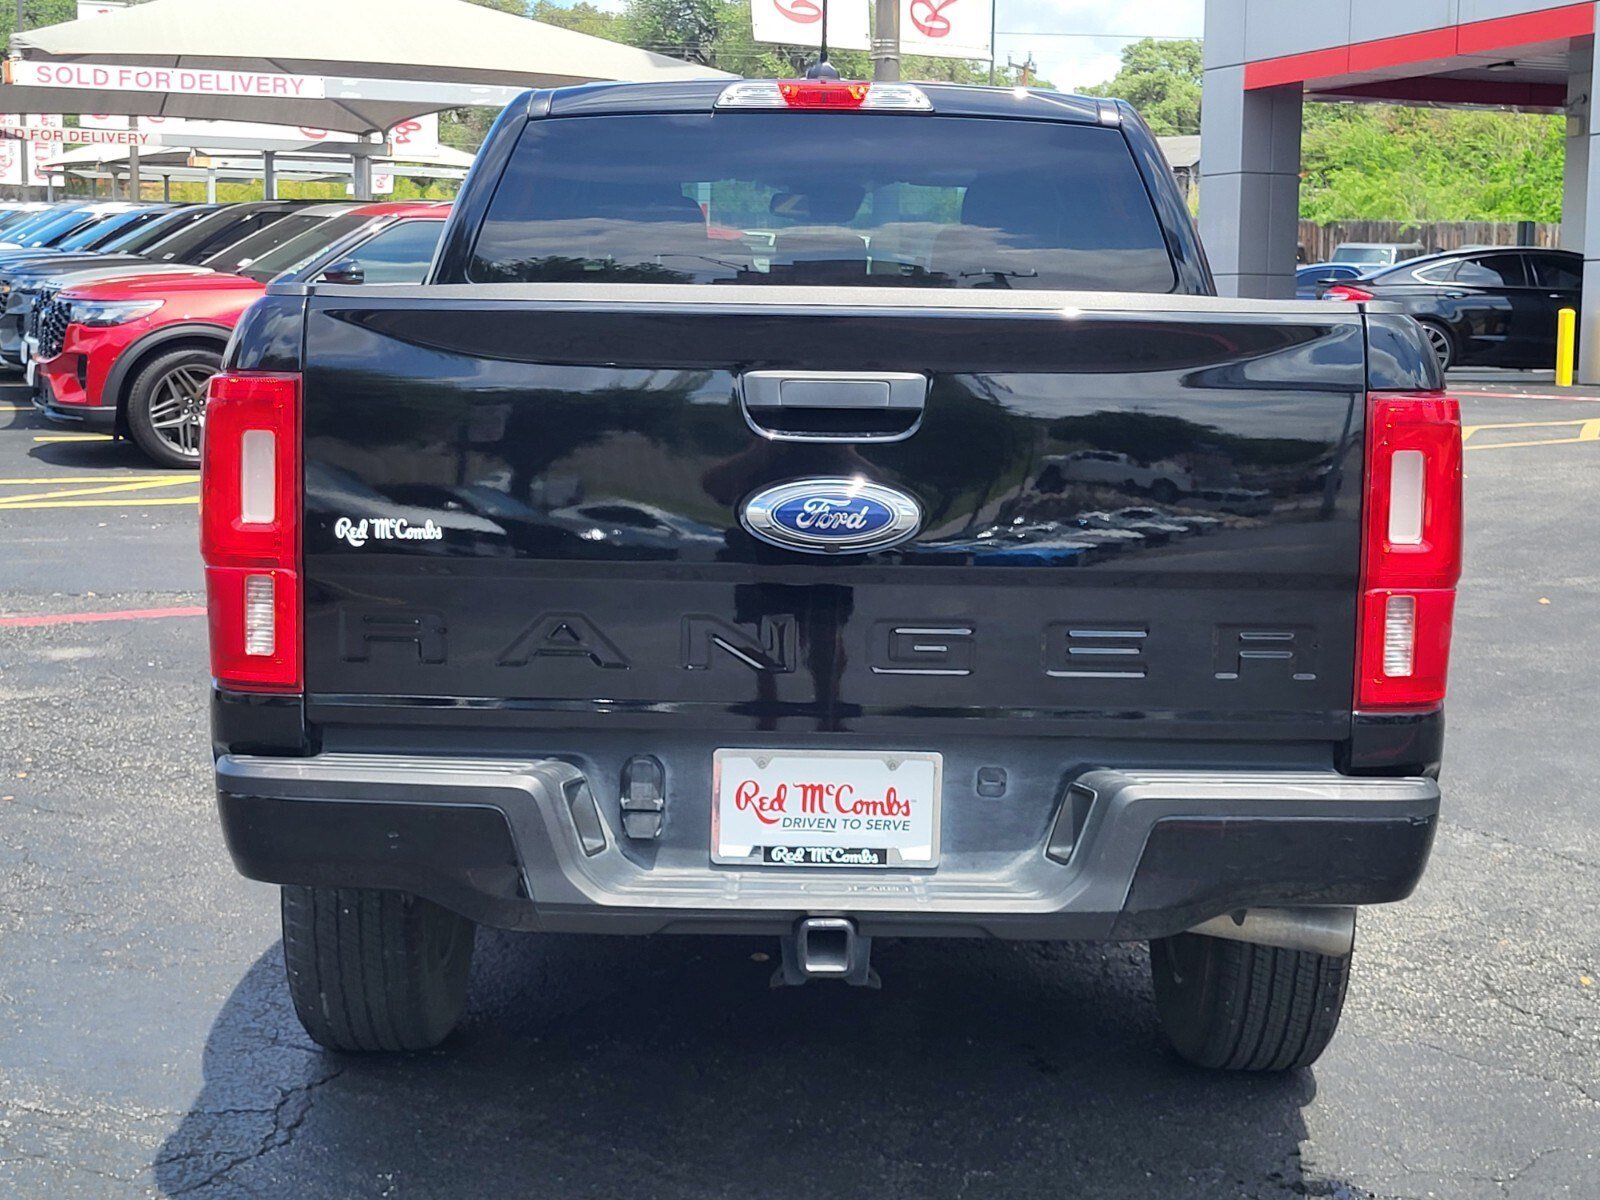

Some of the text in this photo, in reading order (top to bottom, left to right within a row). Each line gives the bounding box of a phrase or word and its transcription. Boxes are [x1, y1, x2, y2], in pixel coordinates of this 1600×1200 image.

[36, 65, 304, 96] SOLD FOR DELIVERY
[0, 127, 149, 144] LD FOR DELIVERY
[795, 498, 870, 530] Ford
[334, 516, 443, 548] Red McCombs
[337, 605, 1318, 680] RANGER
[735, 780, 911, 825] Red McCombs
[782, 817, 911, 832] DRIVEN TO SERVE
[771, 846, 879, 865] Red McCombs
